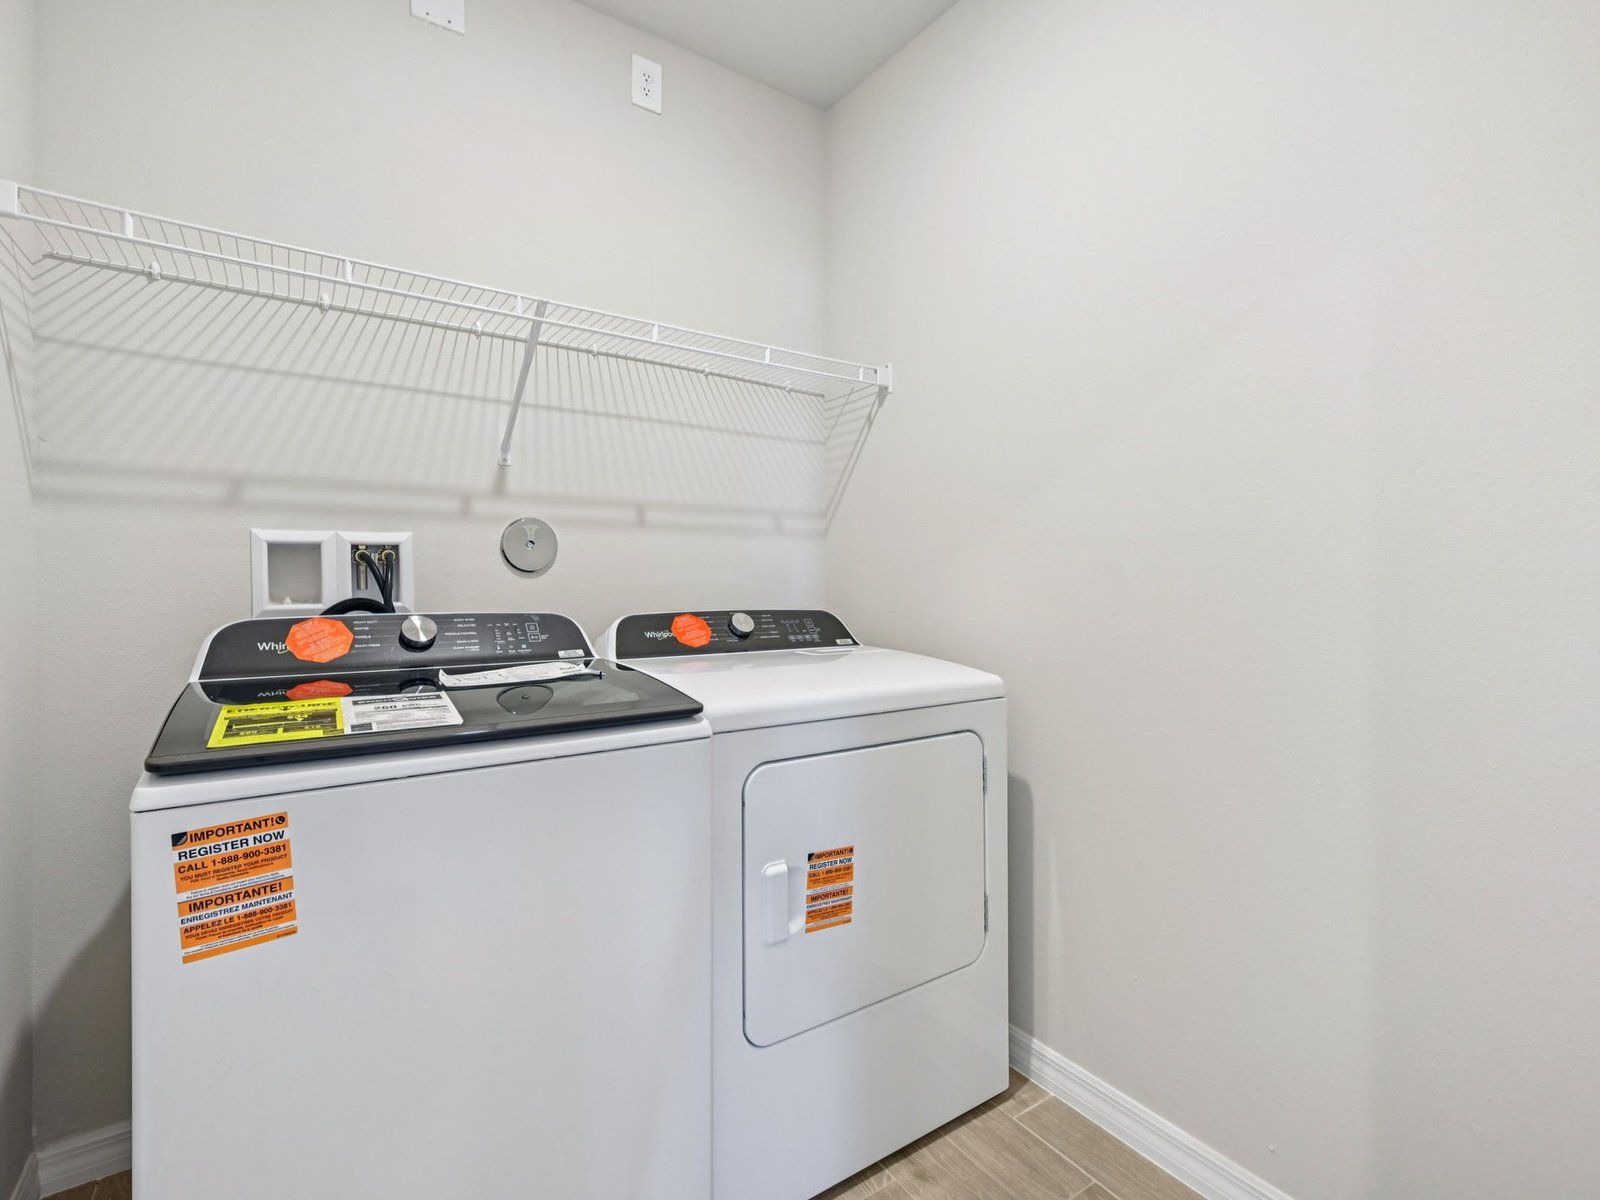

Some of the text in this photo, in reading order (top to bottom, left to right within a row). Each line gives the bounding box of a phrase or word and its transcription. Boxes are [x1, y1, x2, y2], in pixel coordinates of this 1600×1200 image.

[190, 817, 274, 843] IMPORTANT!
[178, 830, 285, 861] REGISTER NOW
[178, 861, 208, 874] CALL
[211, 844, 286, 866] 1-888-900-3381
[180, 873, 194, 882] YOU
[194, 870, 211, 879] MUST
[213, 864, 242, 876] REGISTER
[809, 857, 852, 870] REGISTER NOW
[180, 892, 293, 925] ENREGISTREZ MAINTENANT
[188, 882, 282, 913] IMPORTANTE!
[183, 920, 223, 934] APPELEZ
[224, 916, 235, 925] LE
[237, 902, 292, 921] 1-888-900-3381
